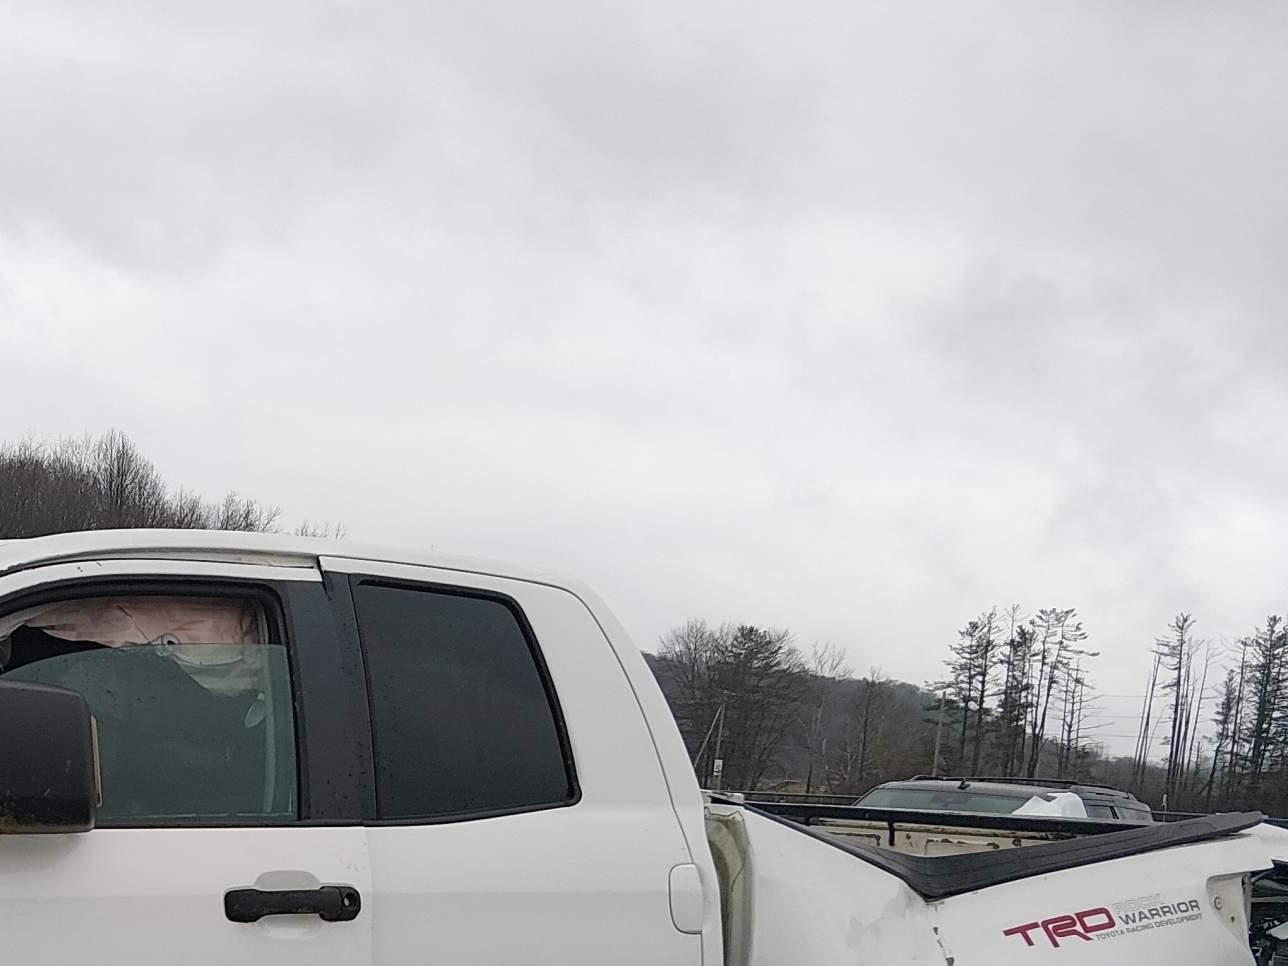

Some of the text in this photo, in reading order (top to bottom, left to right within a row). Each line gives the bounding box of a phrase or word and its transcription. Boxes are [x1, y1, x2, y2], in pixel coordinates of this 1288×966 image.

[1002, 899, 1201, 948] TRD WARRIOR
[1095, 912, 1203, 942] TOYOTA RACING DEVELOPMENT
